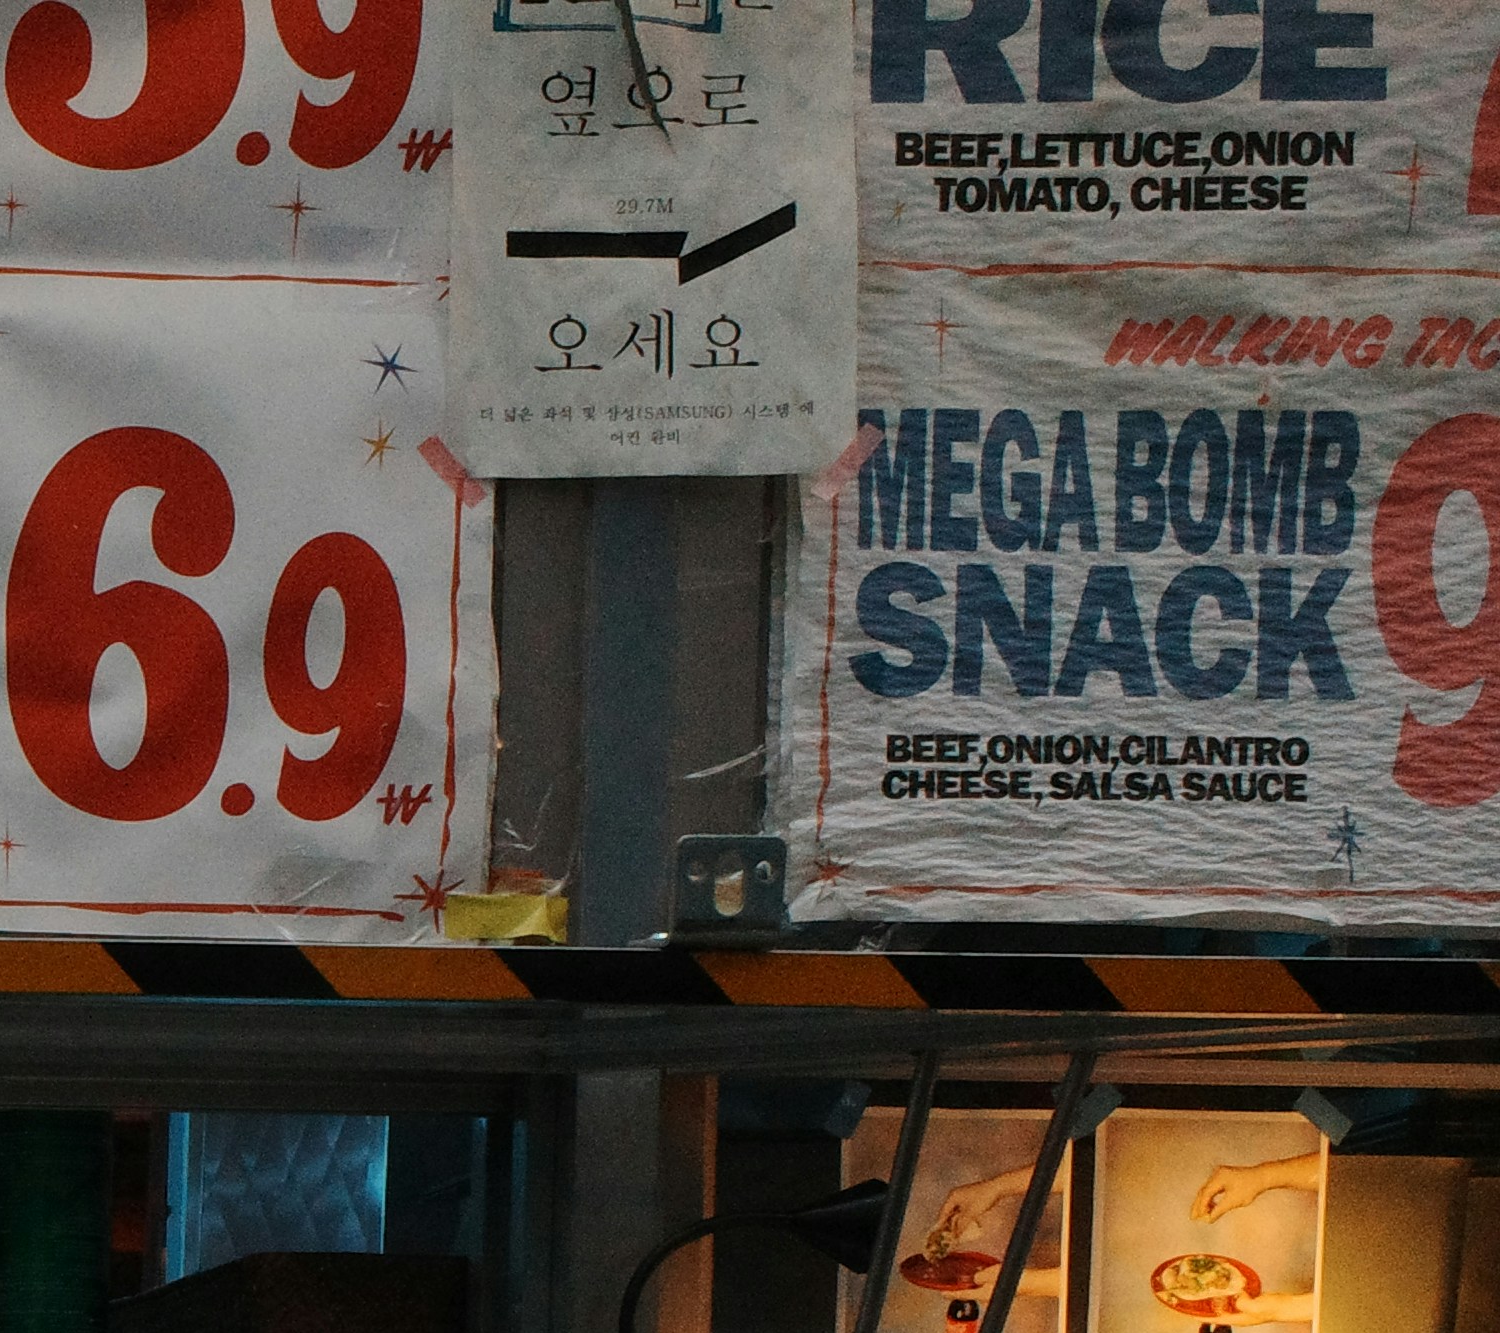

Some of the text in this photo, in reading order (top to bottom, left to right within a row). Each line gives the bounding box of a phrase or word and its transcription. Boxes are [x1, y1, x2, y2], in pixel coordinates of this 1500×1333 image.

[869, 0, 1388, 105] RICE
[541, 65, 760, 137] 옆으로
[934, 175, 1308, 213] TOMATO, CHEESE
[534, 307, 760, 380] 오세요
[1104, 314, 1394, 368] WALKING
[856, 408, 1360, 554] MEGA BOMB
[848, 562, 1357, 702] SNACK
[880, 767, 1308, 803] CHEESE, SALSA SAUCE
